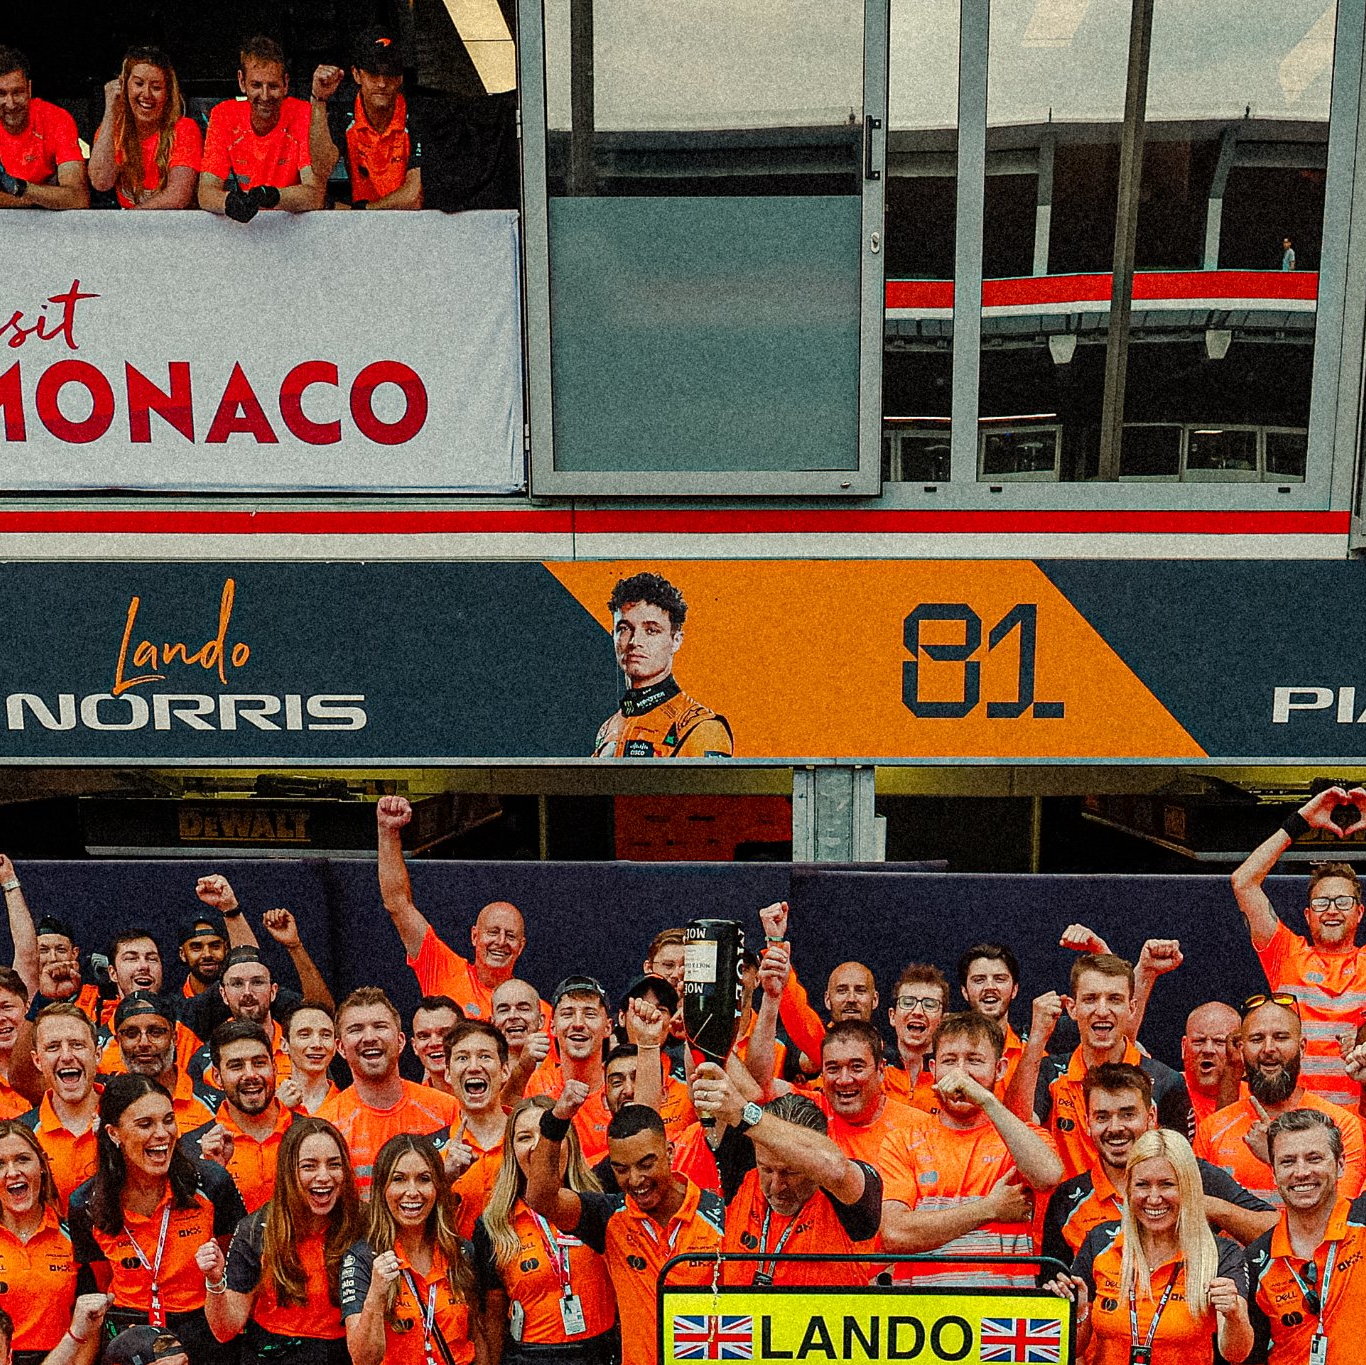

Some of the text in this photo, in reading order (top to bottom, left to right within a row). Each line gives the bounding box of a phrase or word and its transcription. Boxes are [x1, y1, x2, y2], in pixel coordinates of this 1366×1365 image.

[113, 578, 251, 695] Lando
[902, 603, 1065, 719] 81
[6, 693, 368, 731] NORRIS
[1275, 1292, 1296, 1303] DELL
[760, 1315, 974, 1361] LANDO
